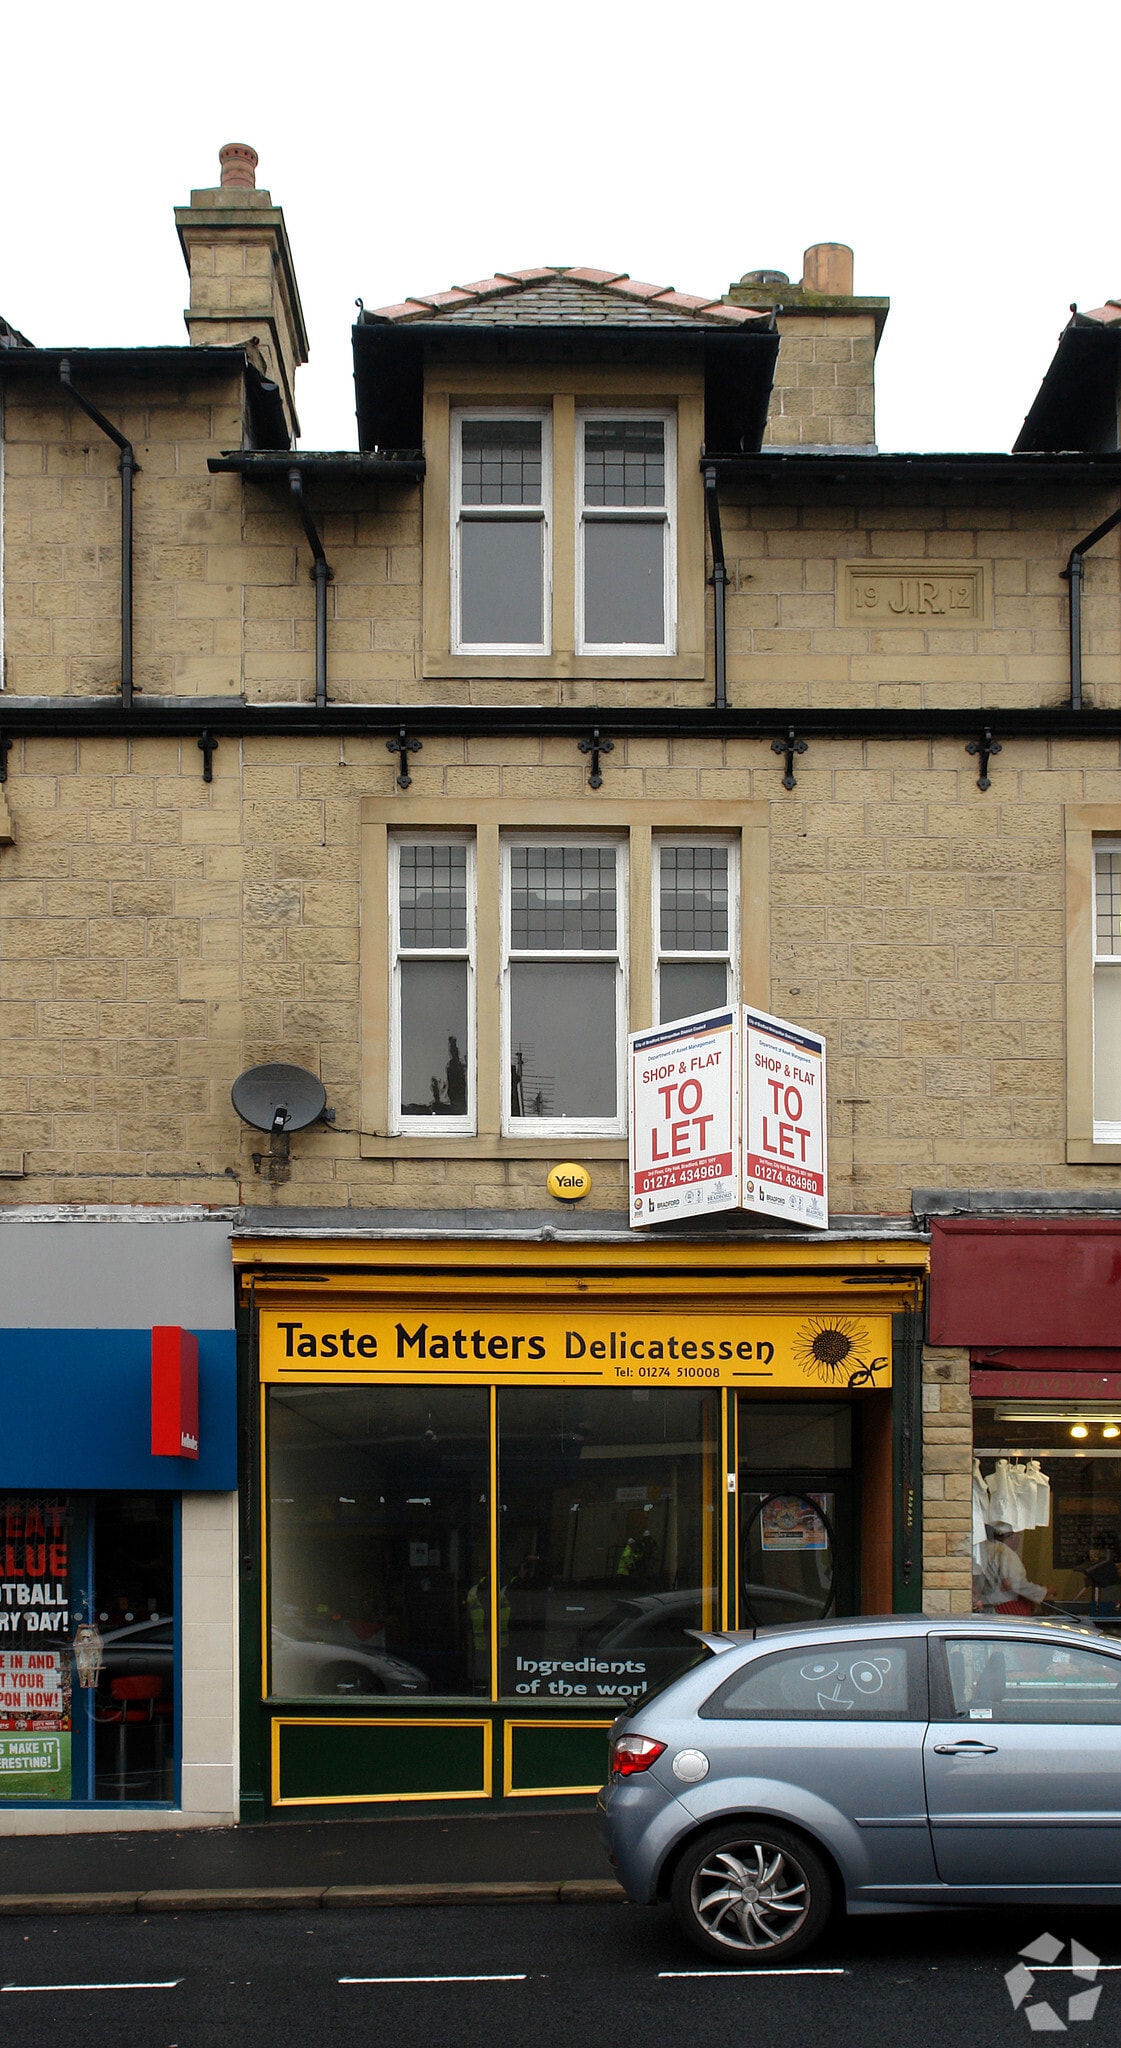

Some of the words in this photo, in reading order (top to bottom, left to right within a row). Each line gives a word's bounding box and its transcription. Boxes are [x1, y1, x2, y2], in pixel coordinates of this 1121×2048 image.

[855, 586, 879, 608] 19
[888, 580, 946, 614] J.R.
[950, 586, 970, 609] 12
[648, 1050, 670, 1062] Department
[689, 1038, 716, 1050] Management
[642, 1064, 675, 1084] SHOP
[679, 1062, 686, 1074] &
[690, 1052, 722, 1071] FLAT
[755, 1053, 782, 1073] SHOP
[784, 1064, 790, 1078] &
[794, 1067, 816, 1086] FLAT
[658, 1078, 703, 1120] TO
[768, 1078, 802, 1122] TO
[652, 1114, 714, 1162] LET
[763, 1116, 811, 1162] LET
[555, 1176, 584, 1188] Yale
[643, 1173, 676, 1190] 01274
[680, 1163, 722, 1183] 434960
[755, 1164, 782, 1183] 01274
[786, 1174, 816, 1192] 434960
[657, 1199, 680, 1208] BRADFORD
[277, 1322, 378, 1358] Taste
[394, 1322, 545, 1360] Matters
[565, 1331, 775, 1365] Delicatessen
[614, 1367, 634, 1378] Tel:
[638, 1368, 670, 1378] 01274
[677, 1368, 720, 1378] 510008
[0, 1506, 66, 1537] EAT
[0, 1584, 68, 1605] TBALL
[26, 1612, 68, 1632] DAY!
[10, 1654, 22, 1668] IN
[28, 1654, 54, 1669] AND
[516, 1656, 646, 1676] Ingredients
[11, 1673, 44, 1688] YOUR
[516, 1680, 541, 1694] of
[548, 1680, 588, 1696] the
[26, 1692, 58, 1707] NOW!
[9, 1742, 39, 1754] MAKE
[43, 1741, 54, 1753] IT
[0, 1756, 52, 1770] RESTING!
